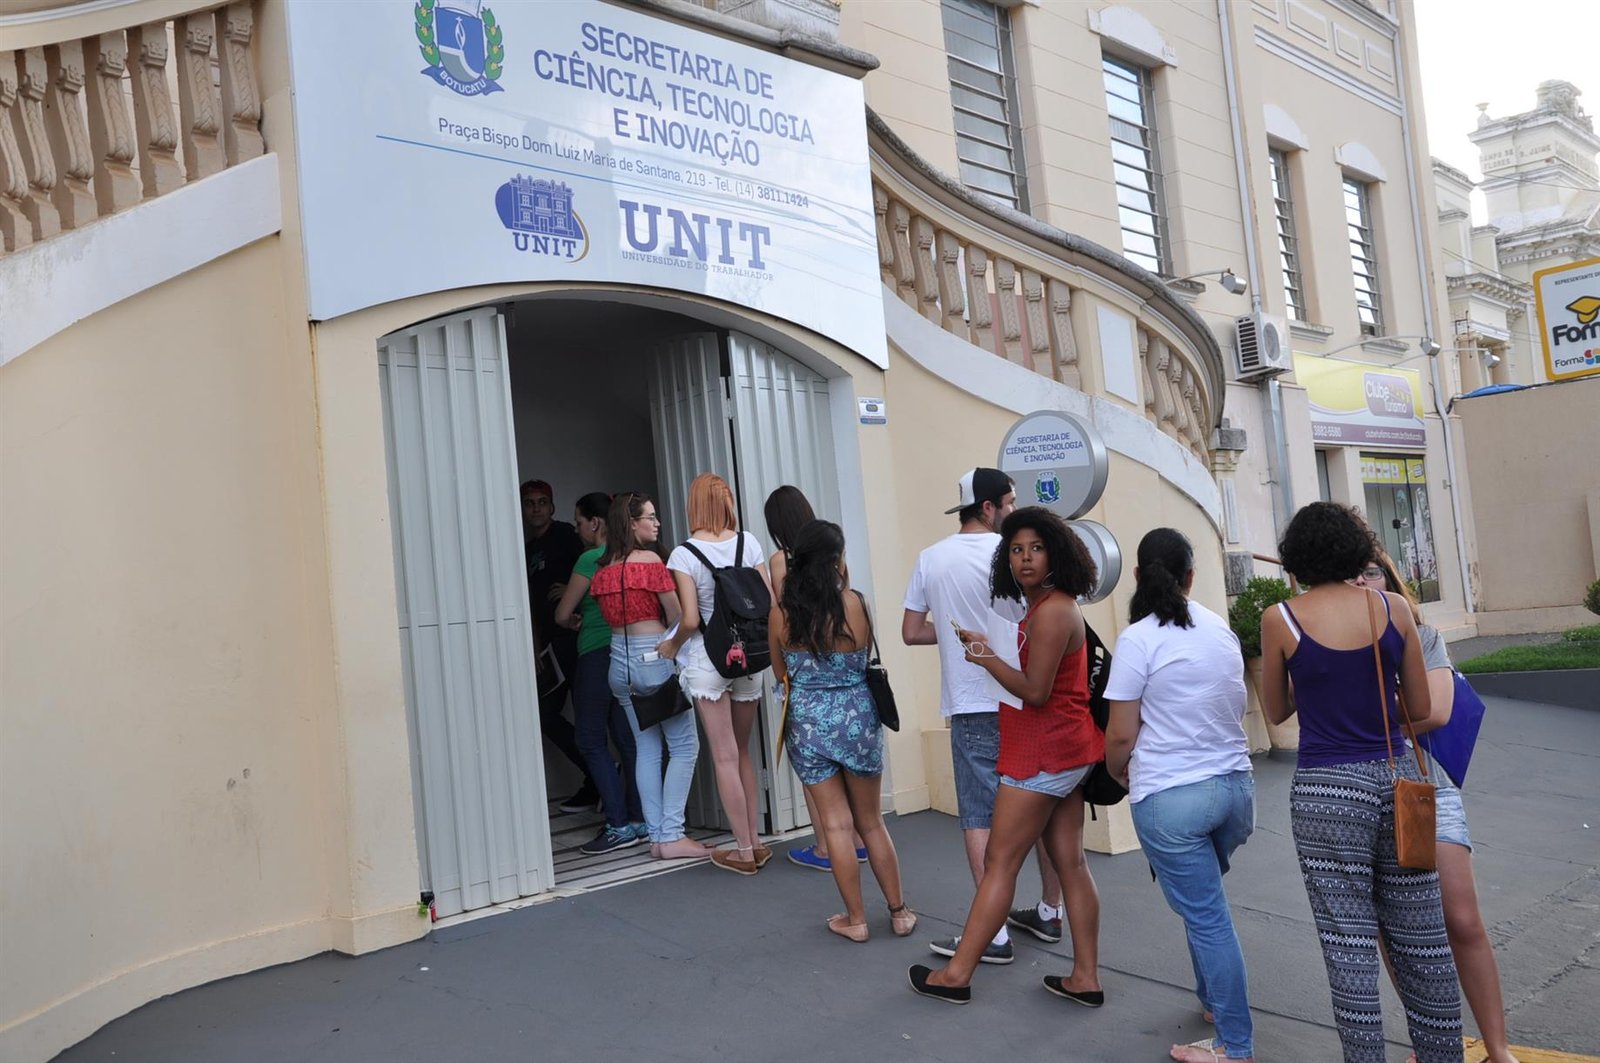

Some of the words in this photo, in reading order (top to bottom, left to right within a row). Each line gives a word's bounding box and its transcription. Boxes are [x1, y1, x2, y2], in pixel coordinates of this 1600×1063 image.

[581, 22, 741, 92] SECRETARIA
[744, 67, 774, 100] DE
[439, 69, 487, 94] BOTUCATU
[533, 49, 662, 112] CIÊNCIA,
[666, 82, 815, 145] TECNOLOGIA
[613, 107, 631, 138] E
[635, 112, 760, 167] INOVAÇÃO
[438, 117, 480, 142] Praça
[482, 127, 519, 149] Bispo
[522, 135, 552, 155] Dom
[555, 142, 581, 161] Luiz
[583, 148, 616, 169] Maria
[619, 157, 633, 172] de
[636, 159, 683, 183] Santana,
[685, 170, 706, 187] 219
[714, 176, 732, 192] Tel.
[735, 180, 755, 200] (14)
[757, 185, 810, 208] 3811.1424
[512, 231, 577, 258] UNIT
[619, 199, 771, 270] UNIT
[622, 250, 693, 269] UNIVERSIDADE
[695, 260, 709, 272] DO
[711, 264, 775, 281] TRABALHADOR
[1554, 272, 1594, 286] REPRESENTANTE
[1554, 356, 1585, 368] Forma
[1365, 381, 1390, 399] Clube
[1017, 434, 1060, 445] SECRETARIA
[1060, 432, 1070, 440] DE
[1038, 441, 1083, 451] TECNOLOGIA
[1024, 455, 1029, 463] E
[1029, 452, 1065, 462] INOVAÇÃO
